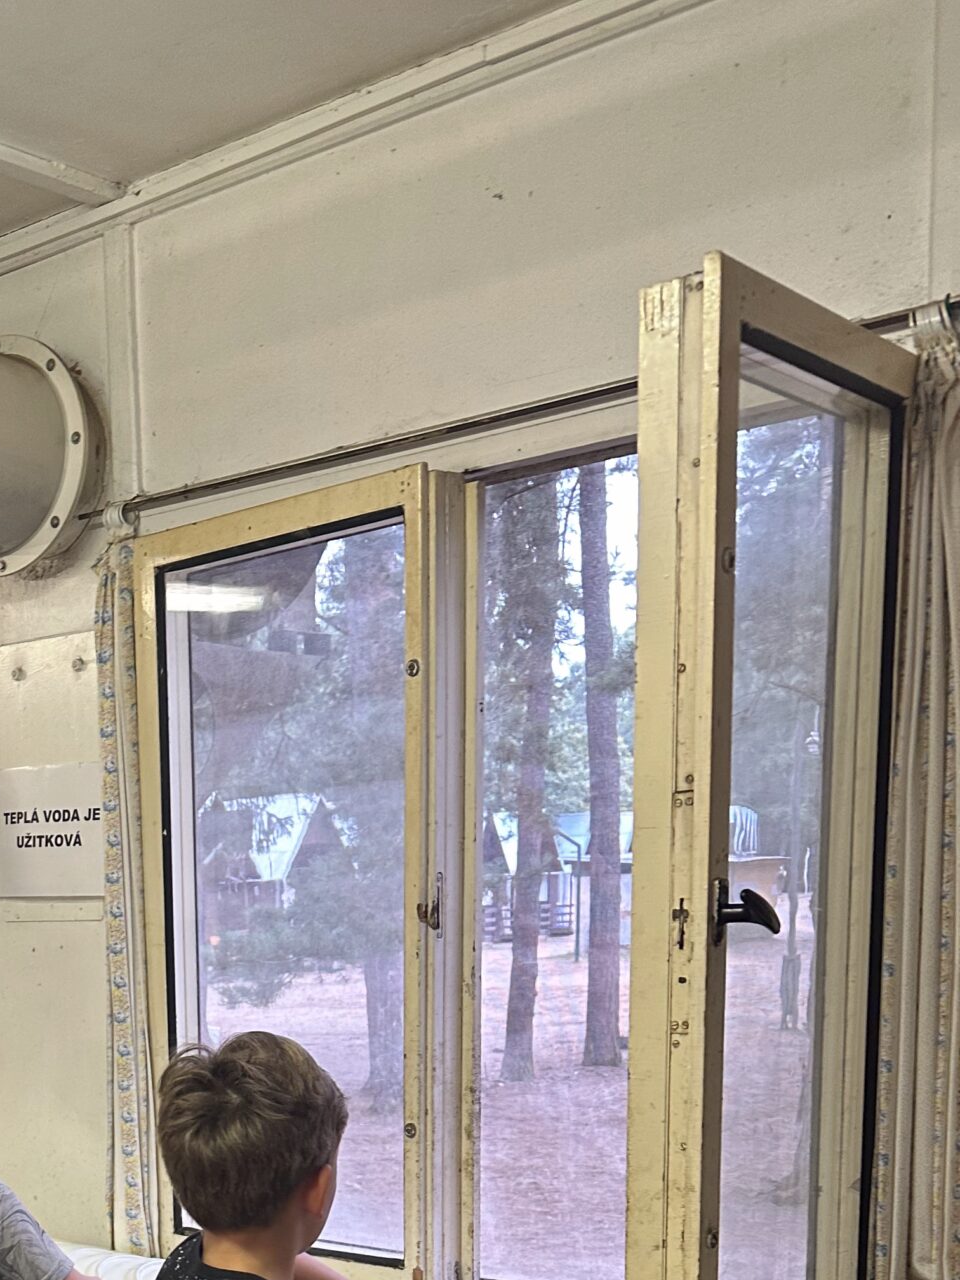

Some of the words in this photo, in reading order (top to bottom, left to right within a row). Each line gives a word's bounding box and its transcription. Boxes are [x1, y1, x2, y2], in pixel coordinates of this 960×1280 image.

[3, 808, 39, 825] TEPLÁ
[43, 809, 80, 823] VODA
[84, 808, 101, 821] JE
[16, 831, 82, 848] UŽITKOVÁ
